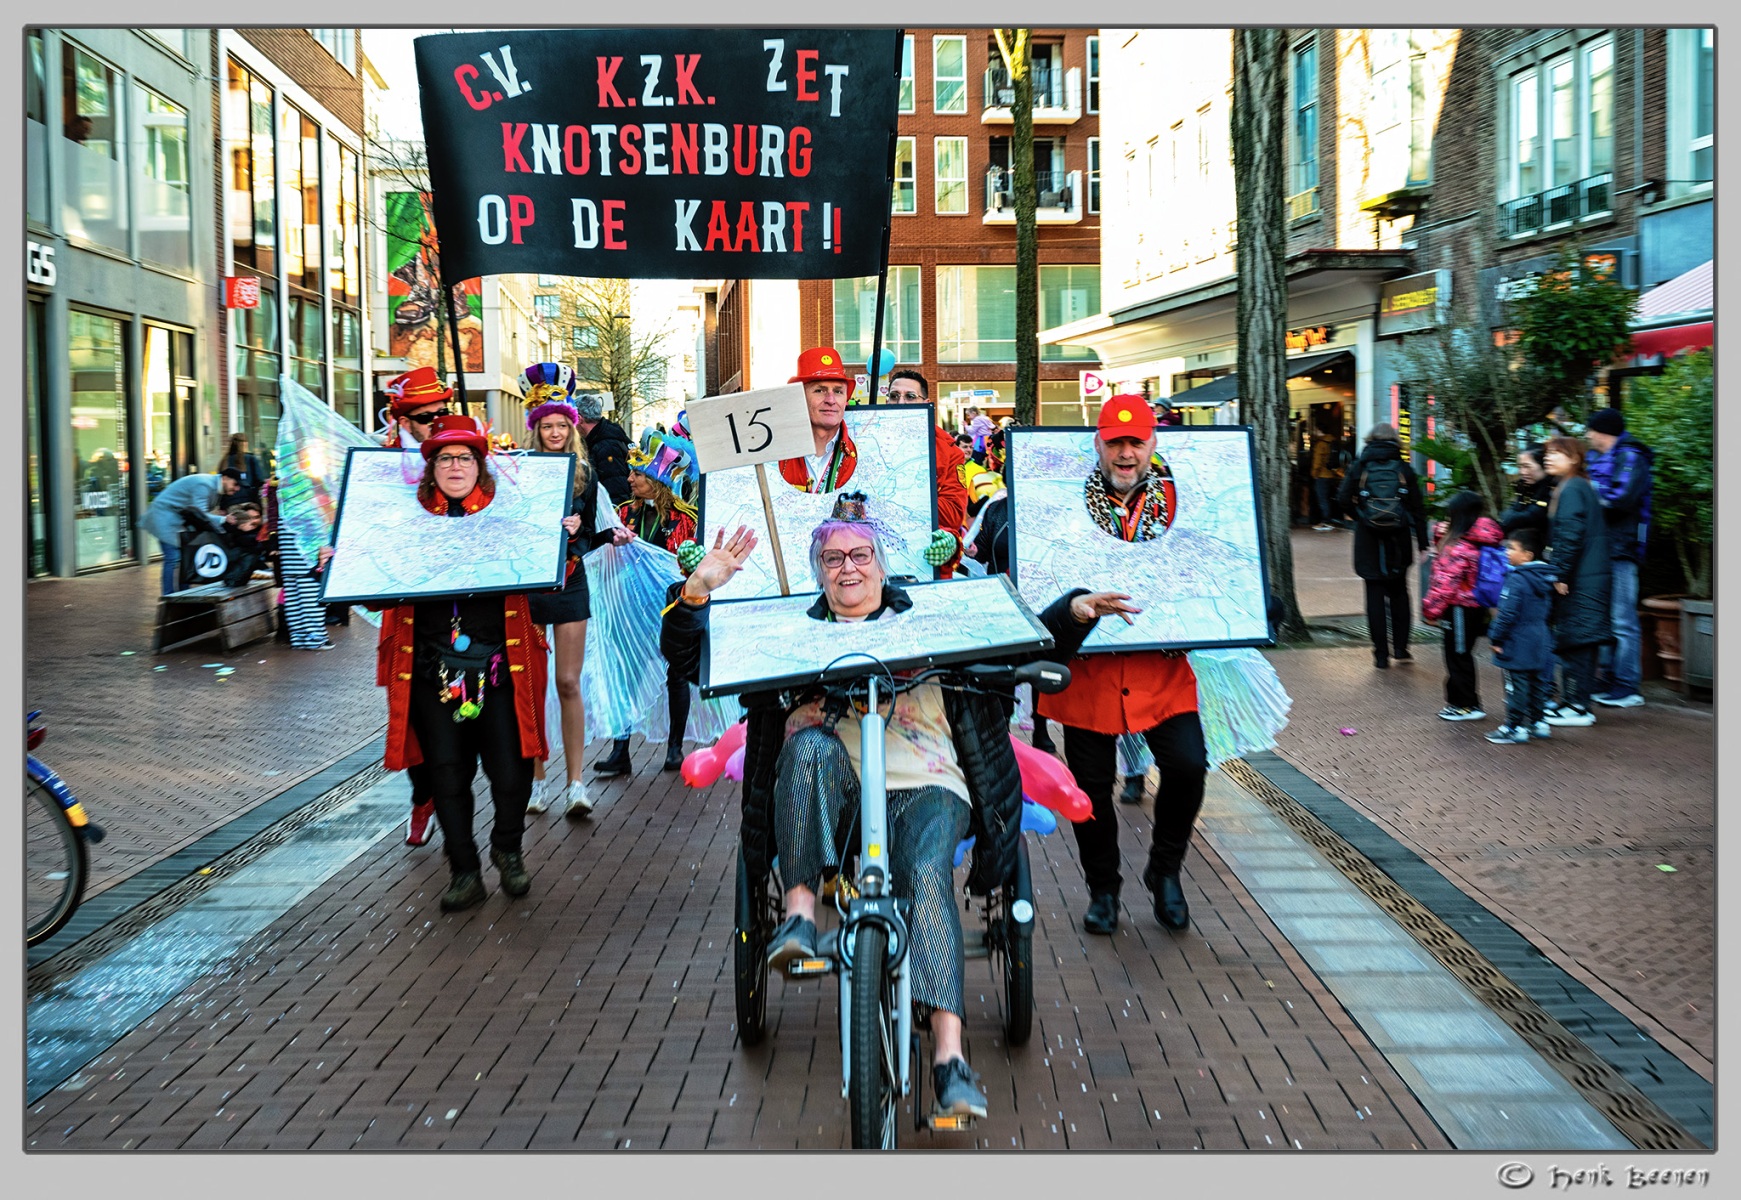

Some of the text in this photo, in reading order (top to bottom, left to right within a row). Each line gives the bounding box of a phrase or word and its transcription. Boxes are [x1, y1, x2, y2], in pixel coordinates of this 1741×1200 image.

[454, 38, 849, 117] C.V. K.Z.K. ZET
[502, 123, 814, 178] KNOTSENBURG
[477, 194, 536, 245] OP
[572, 197, 628, 250] DE
[675, 199, 810, 252] KAART
[725, 406, 773, 454] 15
